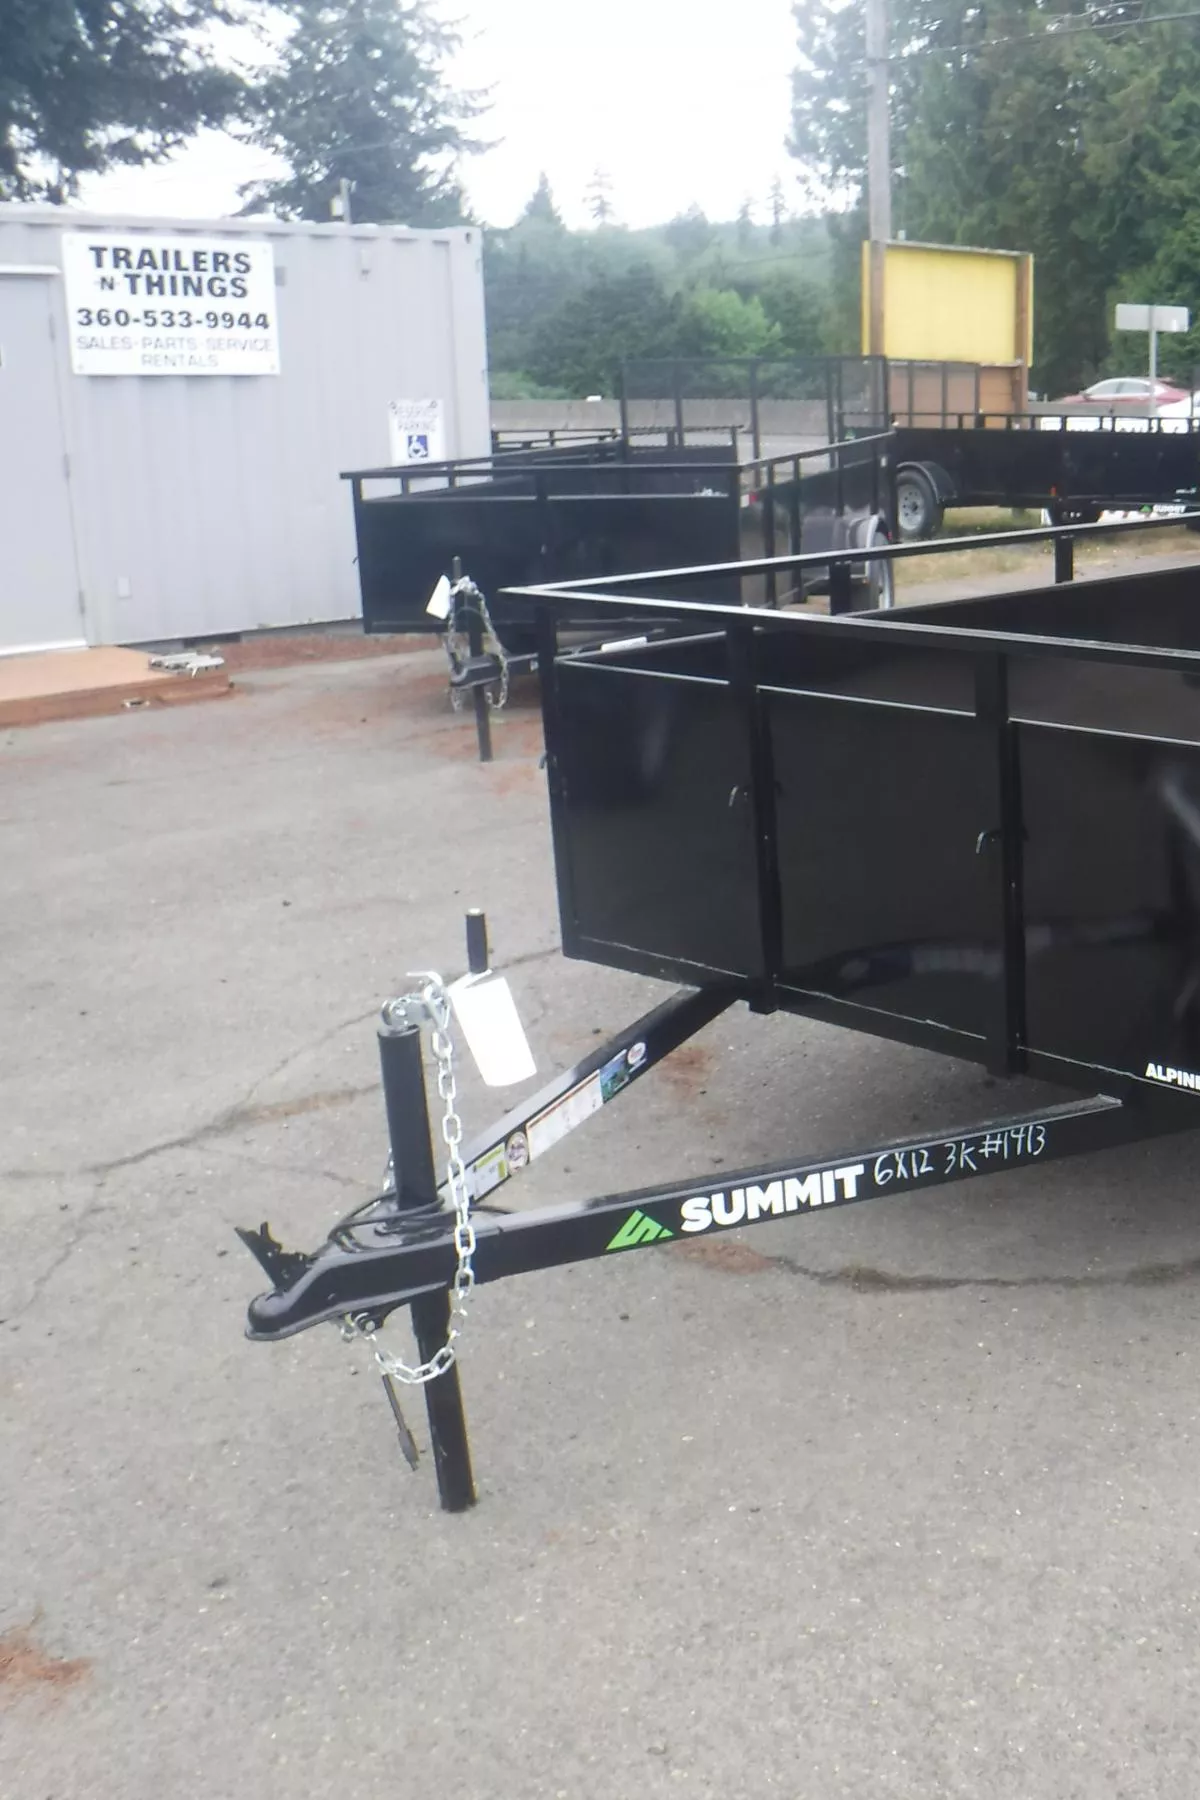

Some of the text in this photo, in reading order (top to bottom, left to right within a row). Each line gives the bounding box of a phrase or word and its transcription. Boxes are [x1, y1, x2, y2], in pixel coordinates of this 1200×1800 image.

[89, 246, 251, 274] TRAILERS
[124, 273, 249, 299] THINGS
[77, 308, 270, 330] 360-533-9944
[77, 336, 273, 352] SALES PARTS SERVICE
[141, 354, 219, 368] RENTALS
[944, 1143, 978, 1175] 3K
[680, 1164, 865, 1233] SUMMIT
